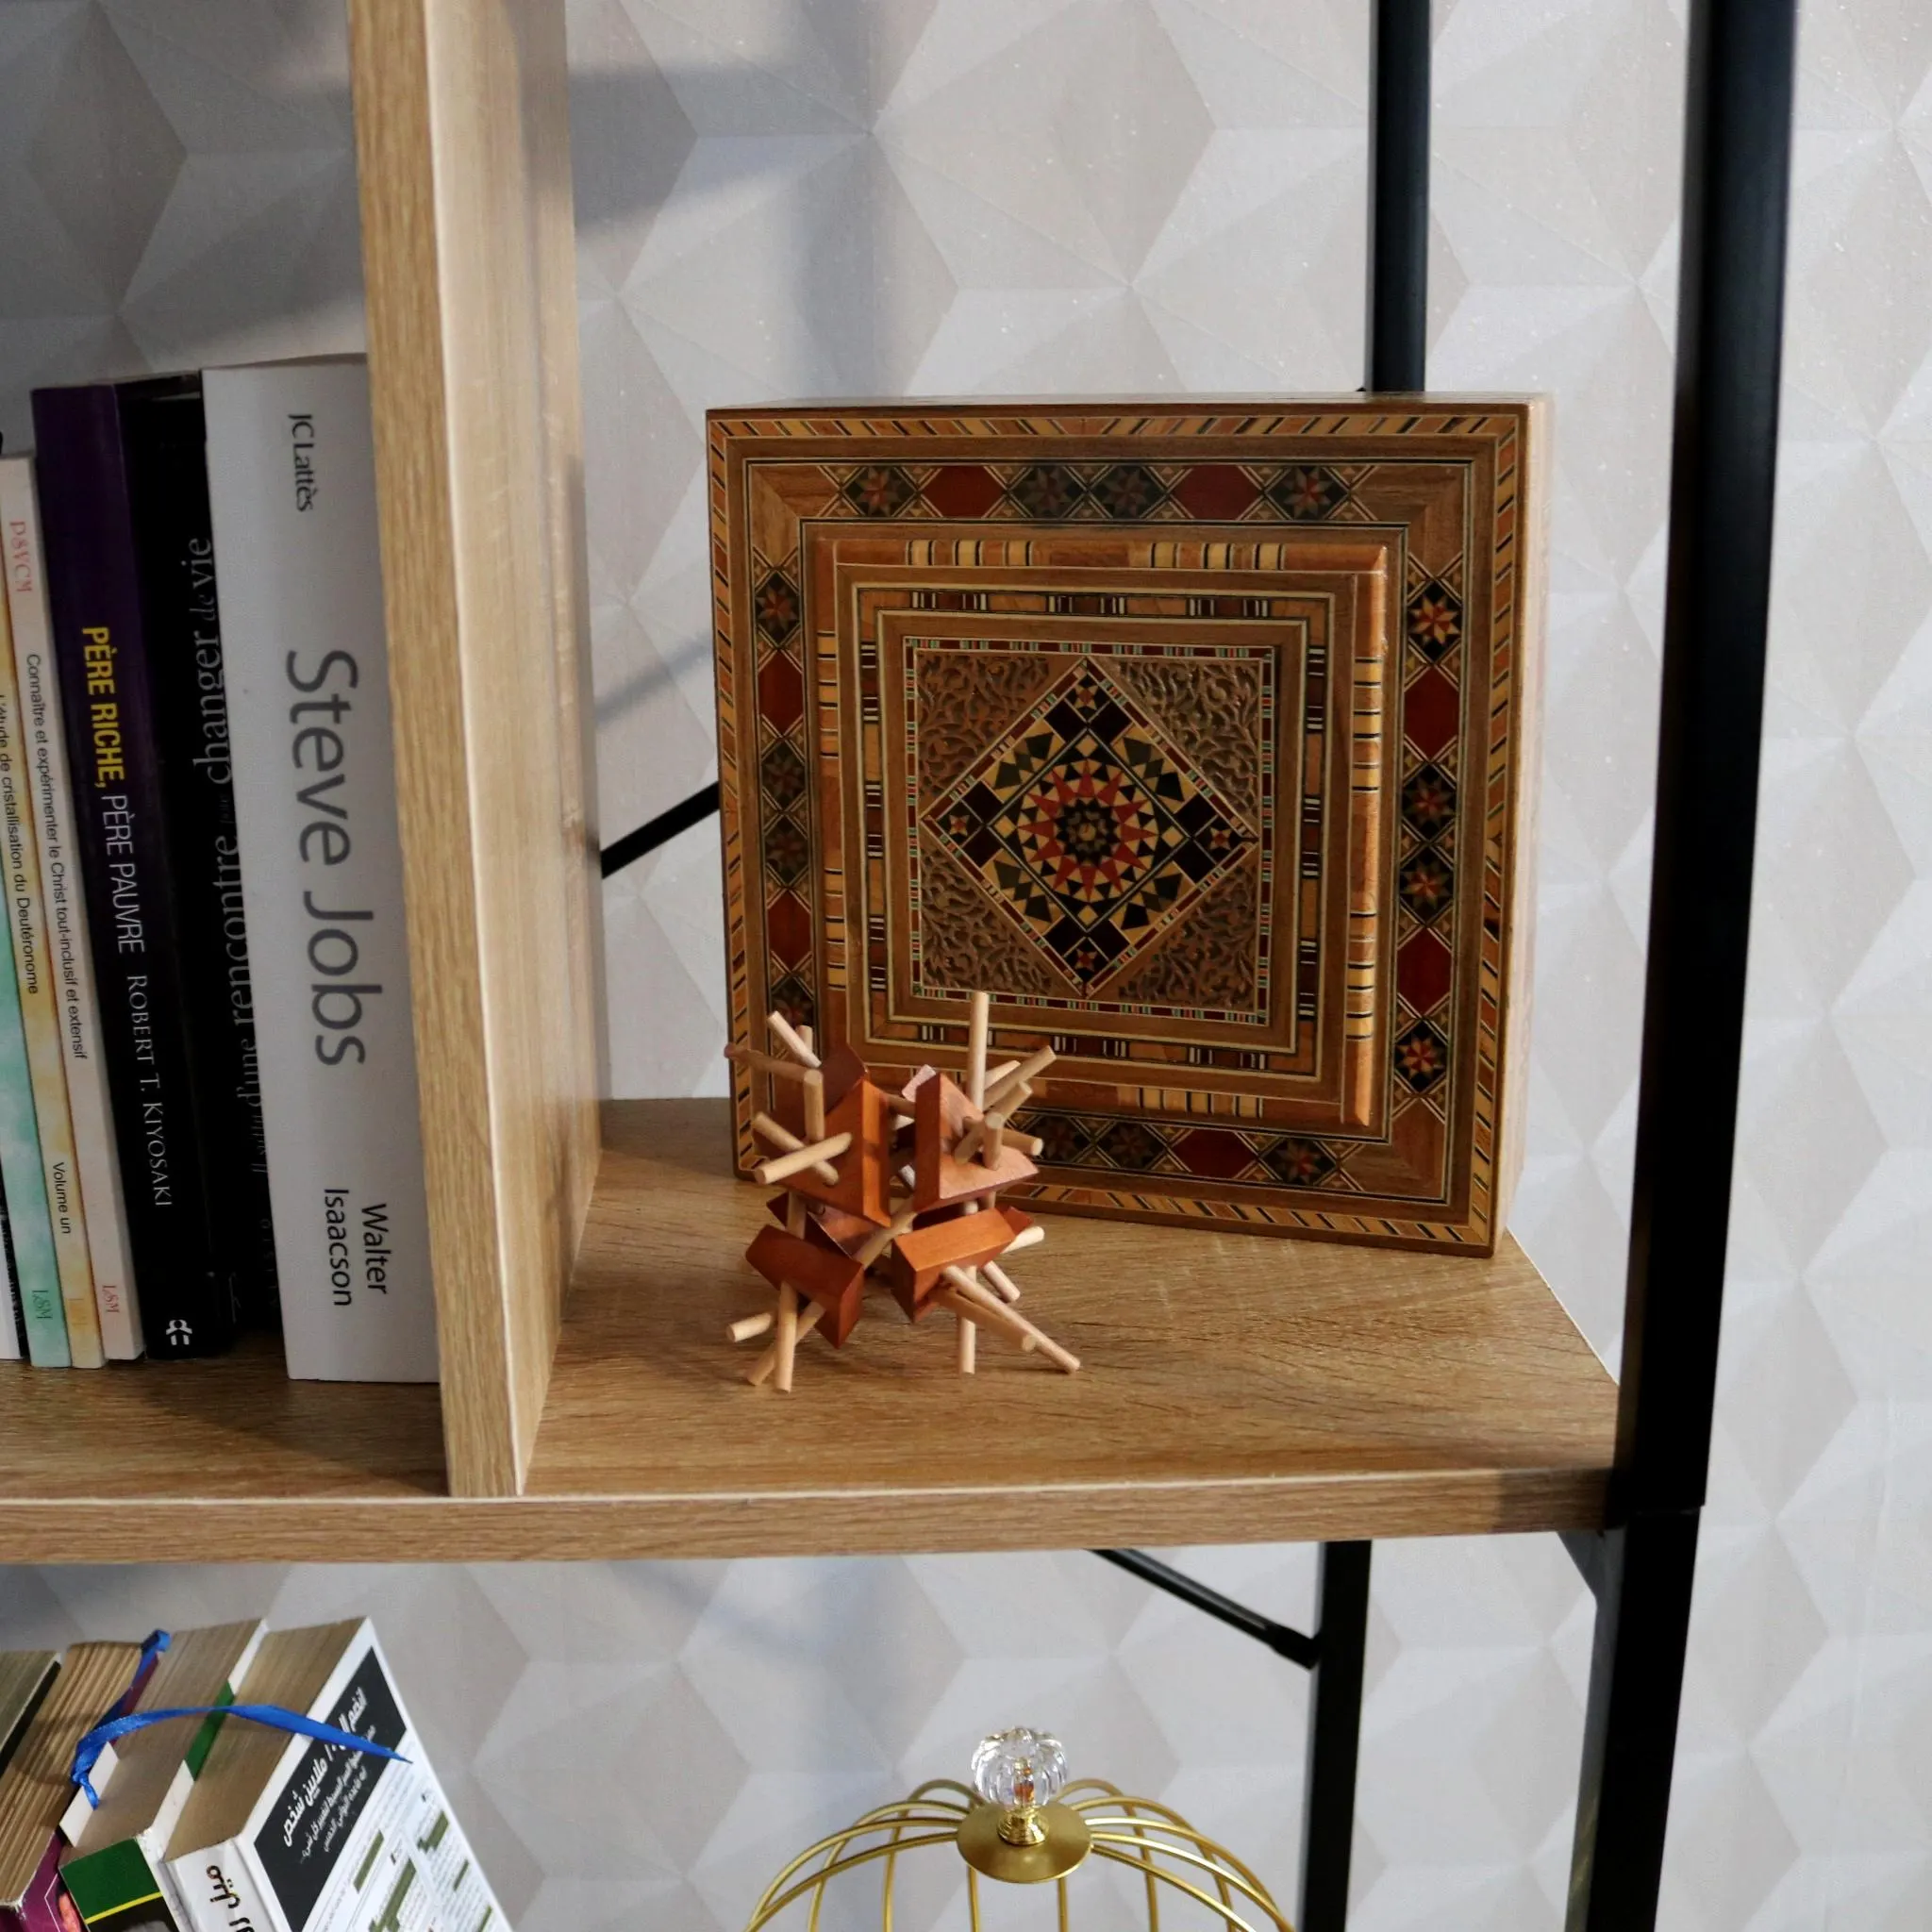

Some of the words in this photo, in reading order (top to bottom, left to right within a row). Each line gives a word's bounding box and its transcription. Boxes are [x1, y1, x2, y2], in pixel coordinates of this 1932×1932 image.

[179, 536, 215, 589] vie
[189, 594, 217, 622] de
[26, 653, 46, 726] Connaître
[82, 626, 118, 696] PÈRE
[35, 729, 48, 743] et
[192, 629, 232, 785] changer
[0, 751, 10, 772] de
[91, 703, 125, 789] RICHE,
[286, 649, 358, 866] Steve
[1, 776, 23, 870] cristallisation
[35, 745, 58, 841] expérimenter
[101, 795, 135, 857] PÈRE
[13, 874, 27, 892] du
[48, 843, 61, 858] le
[51, 862, 65, 902] Christ
[108, 861, 145, 954] PAUVRE
[211, 834, 254, 1027] rencontre
[17, 897, 39, 994] Deutéronome
[57, 904, 79, 988] tout-inclusif
[303, 891, 383, 1066] Jobs
[67, 989, 79, 1002] et
[68, 1005, 88, 1059] extensif
[126, 974, 155, 1064] ROBERT
[140, 1074, 160, 1092] T.
[142, 1102, 173, 1208] KIYOSAKI
[52, 1161, 68, 1213] Volume
[60, 1217, 72, 1235] un
[324, 1189, 352, 1307] Isaacson
[361, 1203, 392, 1294] Walter
[283, 1790, 305, 1847] شخص
